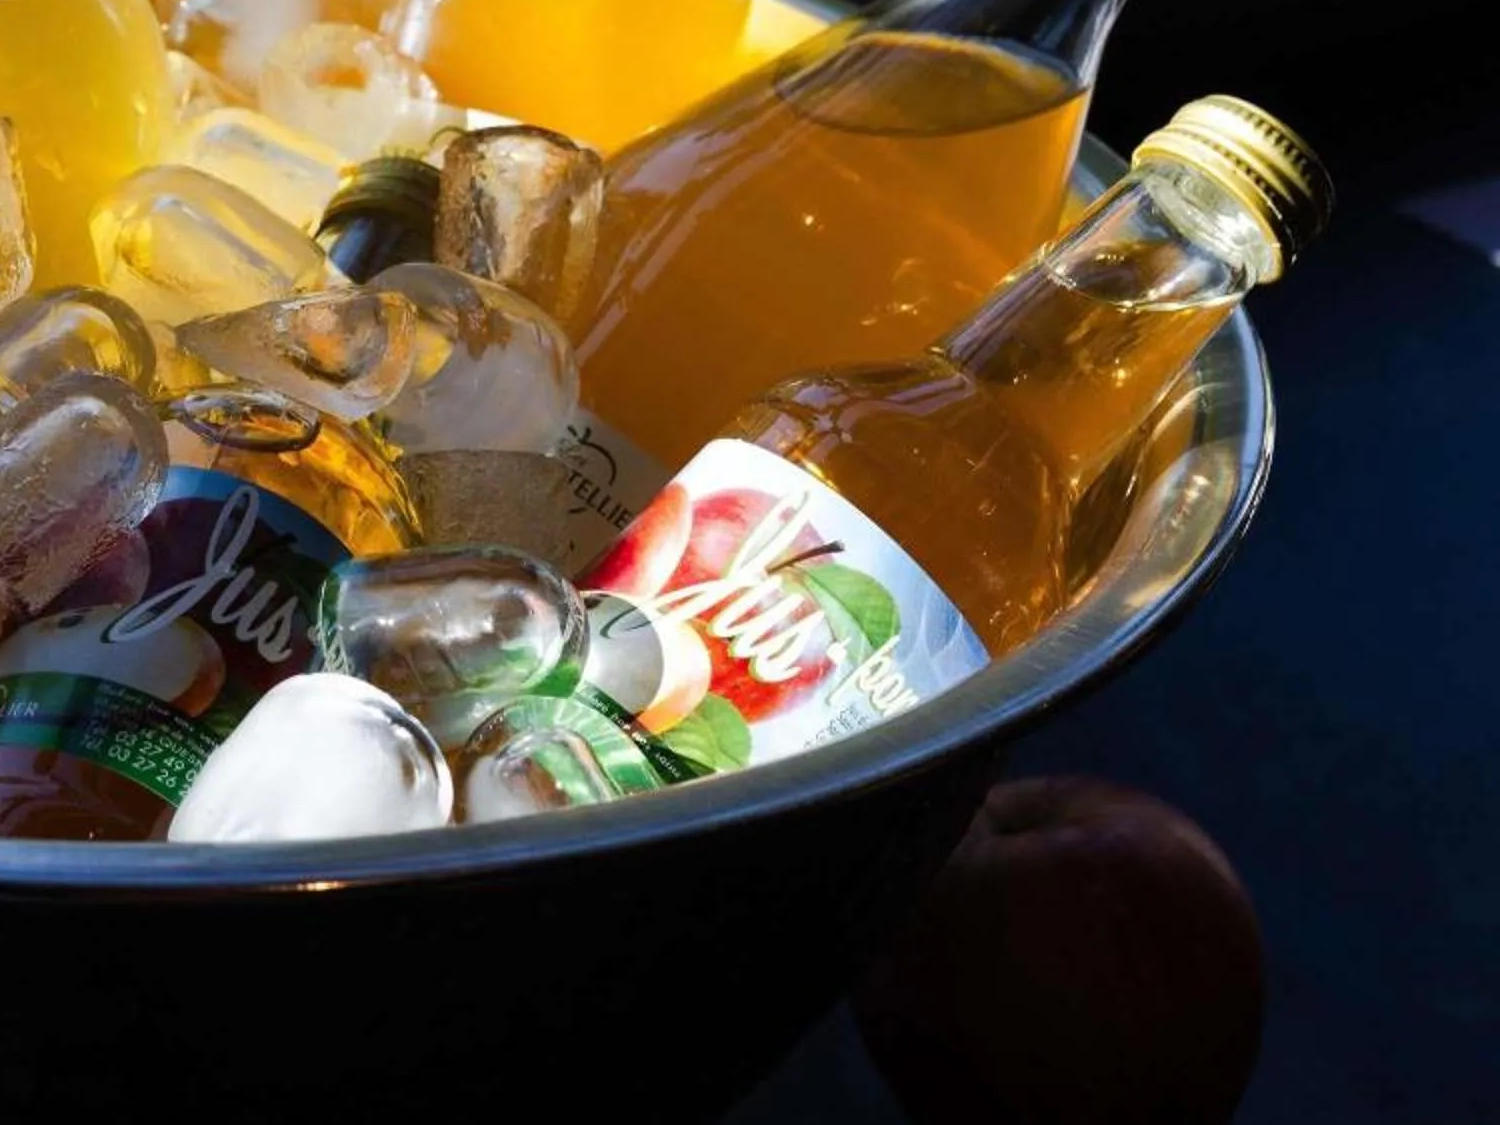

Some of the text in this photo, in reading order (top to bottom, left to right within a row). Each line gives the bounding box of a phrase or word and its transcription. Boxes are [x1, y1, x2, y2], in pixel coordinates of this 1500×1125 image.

[104, 485, 300, 664] Jus
[600, 490, 825, 684] Jus
[107, 744, 131, 763] 03
[132, 755, 157, 772] 27
[155, 767, 178, 789] 26
[115, 730, 138, 748] 03
[139, 741, 163, 757] 27
